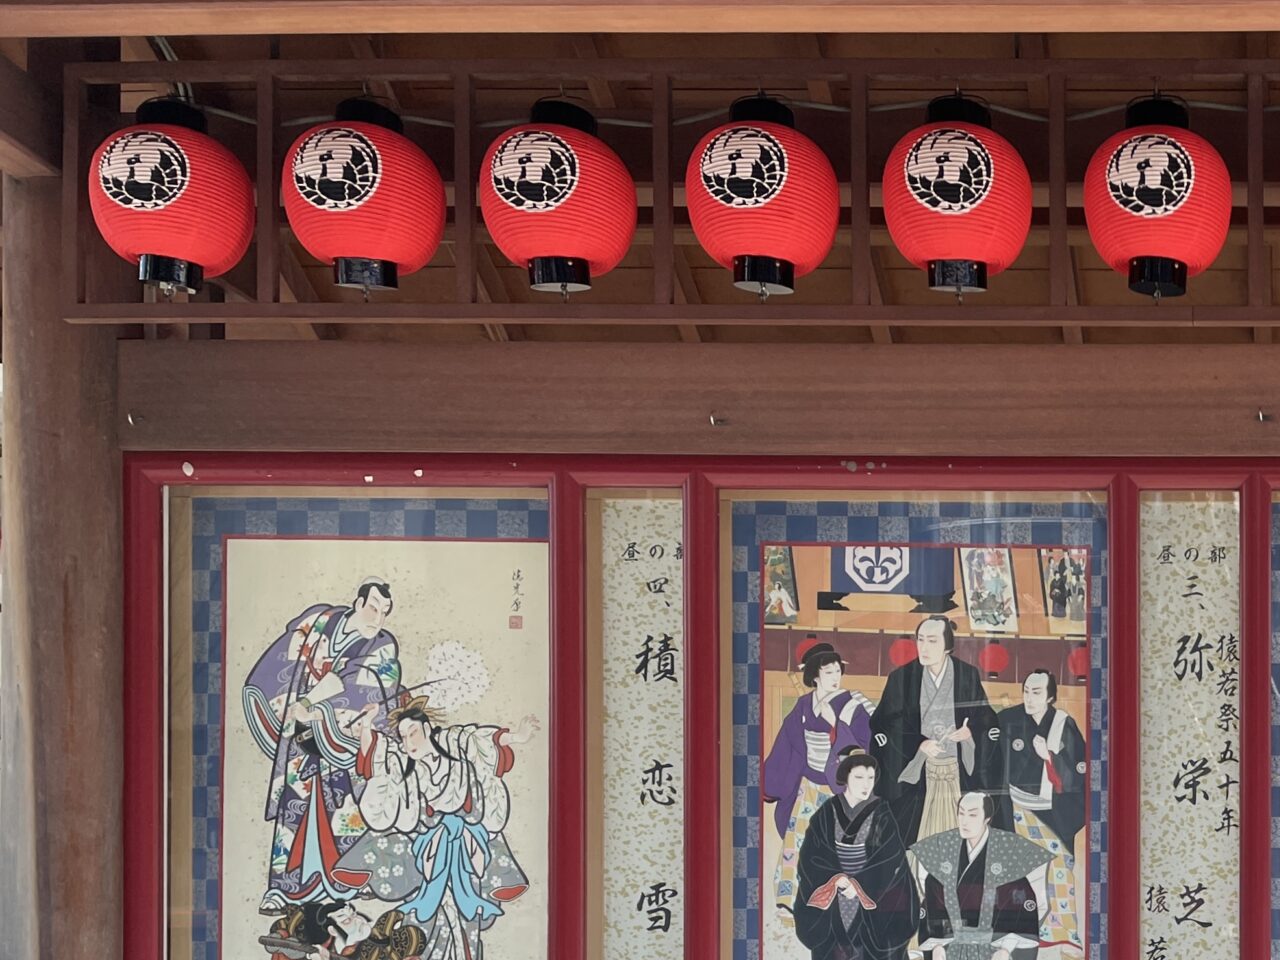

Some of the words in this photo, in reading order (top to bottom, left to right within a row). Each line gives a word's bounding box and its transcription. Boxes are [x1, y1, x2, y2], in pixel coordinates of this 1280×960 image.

[1157, 545, 1226, 565] 昼の部
[1215, 634, 1240, 837] 猿若祭五十年
